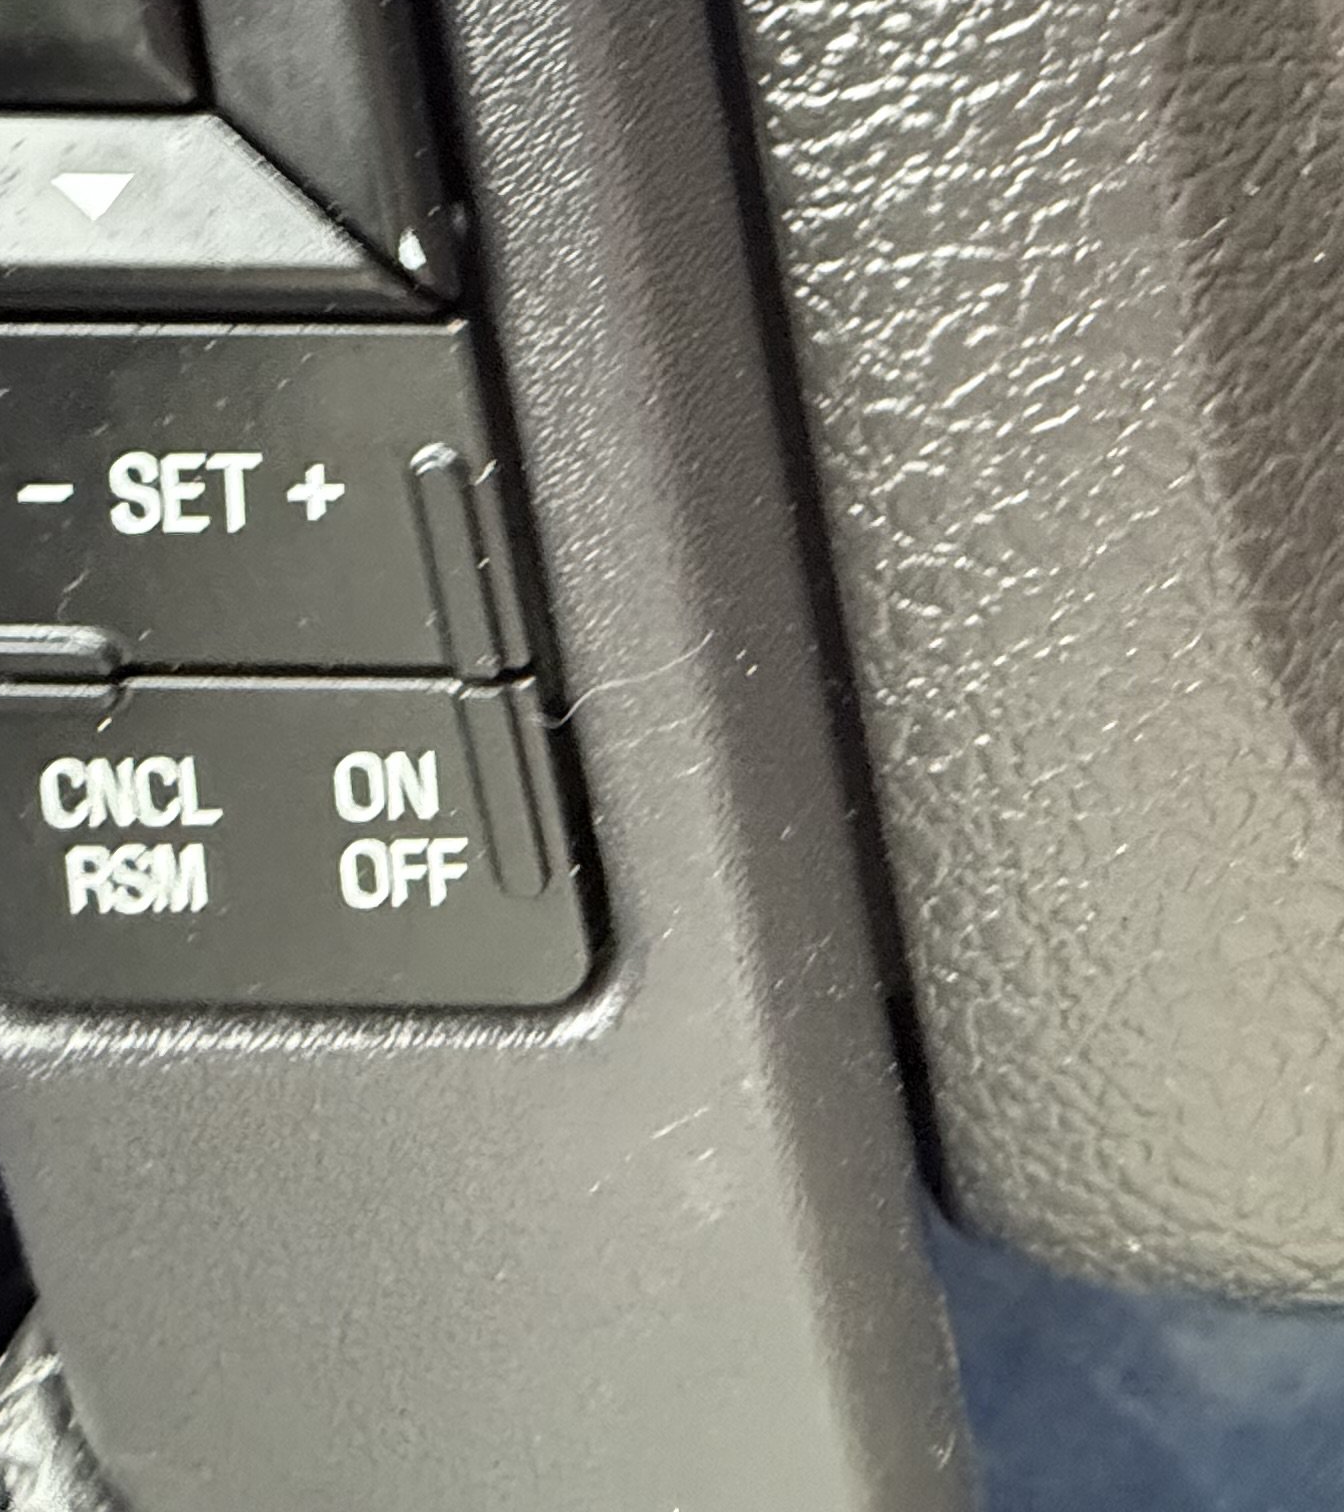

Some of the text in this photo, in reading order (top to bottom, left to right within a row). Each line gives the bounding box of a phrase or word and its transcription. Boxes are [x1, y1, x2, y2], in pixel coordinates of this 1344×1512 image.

[108, 450, 264, 535] SET
[38, 754, 224, 830] CNCL
[333, 749, 440, 824] ON
[64, 842, 209, 916] RSM
[339, 836, 469, 910] OFF
